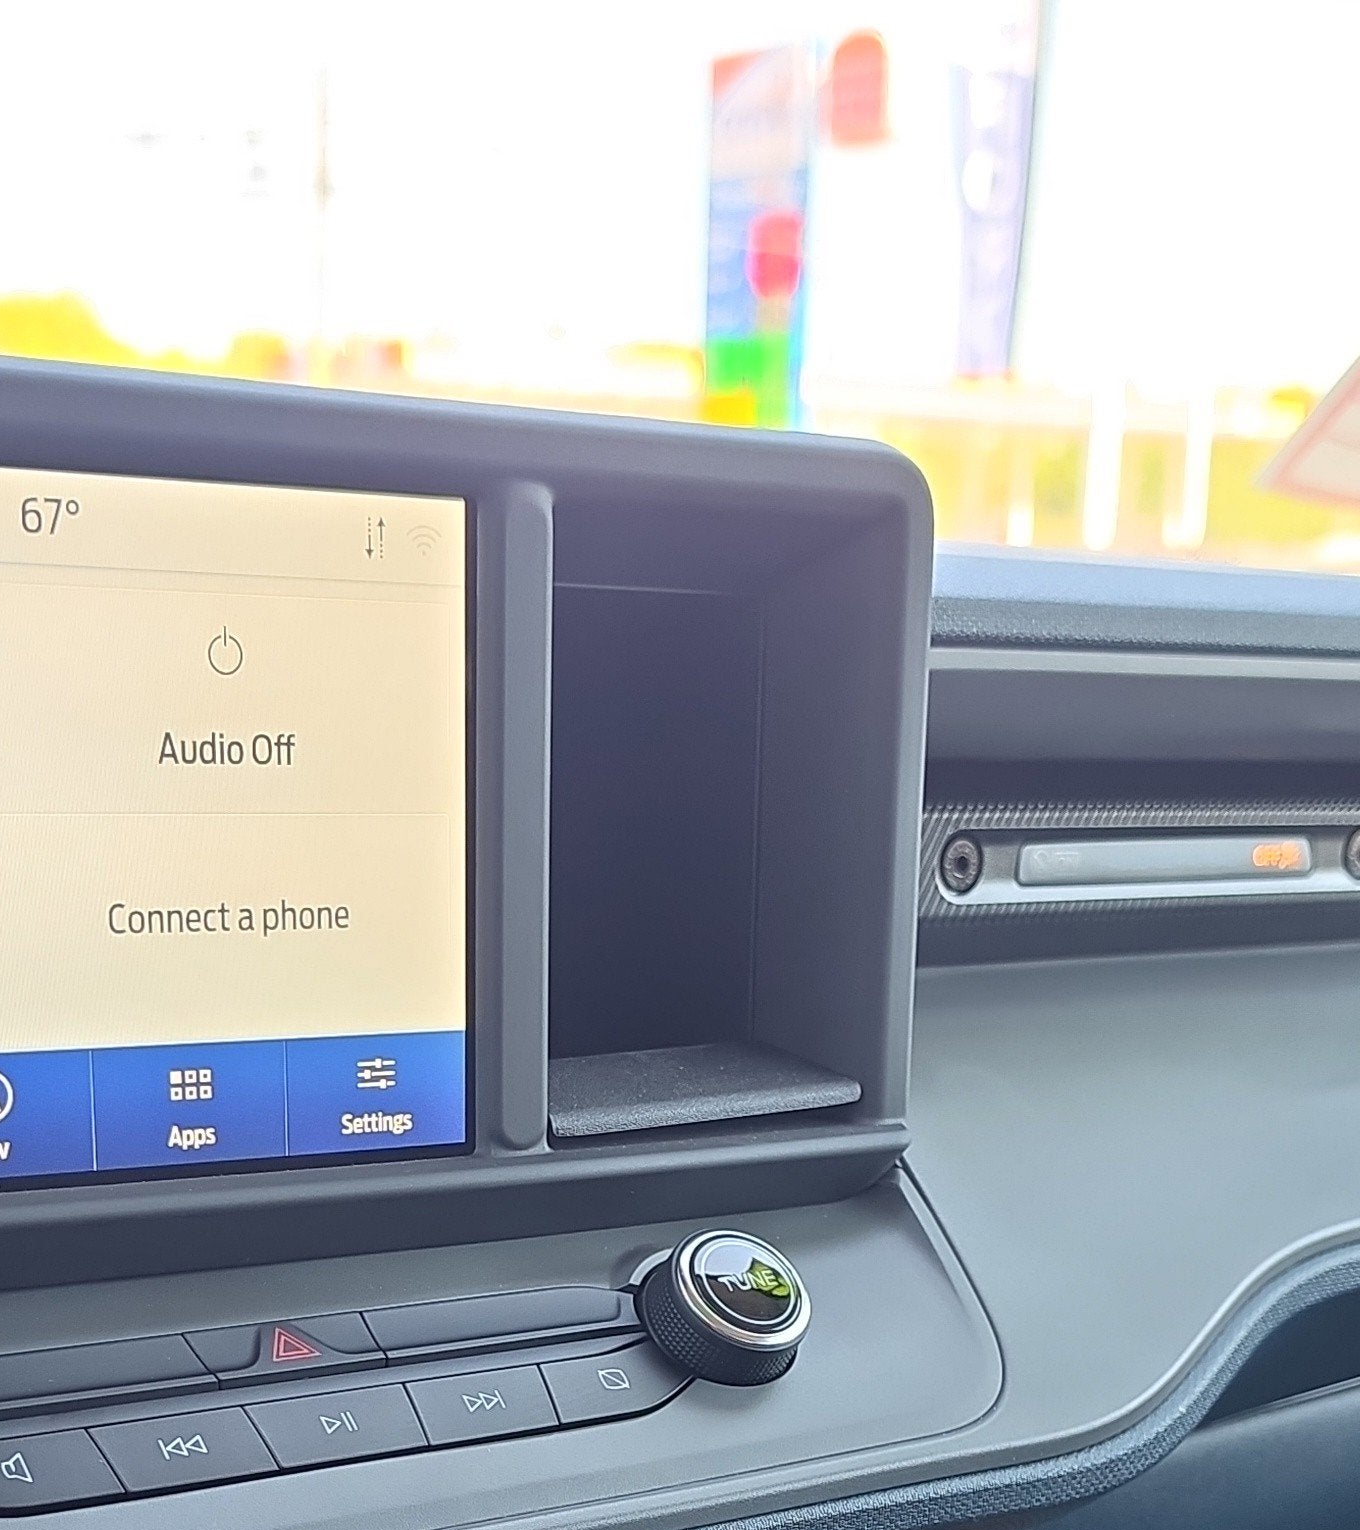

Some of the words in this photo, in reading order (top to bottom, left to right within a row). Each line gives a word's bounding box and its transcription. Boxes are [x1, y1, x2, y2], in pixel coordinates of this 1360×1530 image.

[21, 497, 80, 535] 67°
[158, 731, 244, 765] Audio
[251, 733, 296, 766] Off
[108, 901, 231, 934] Connect
[237, 907, 255, 932] a
[262, 898, 350, 938] phone
[167, 1124, 217, 1149] Apps
[340, 1110, 413, 1136] Settings
[717, 1269, 780, 1292] TUNE
